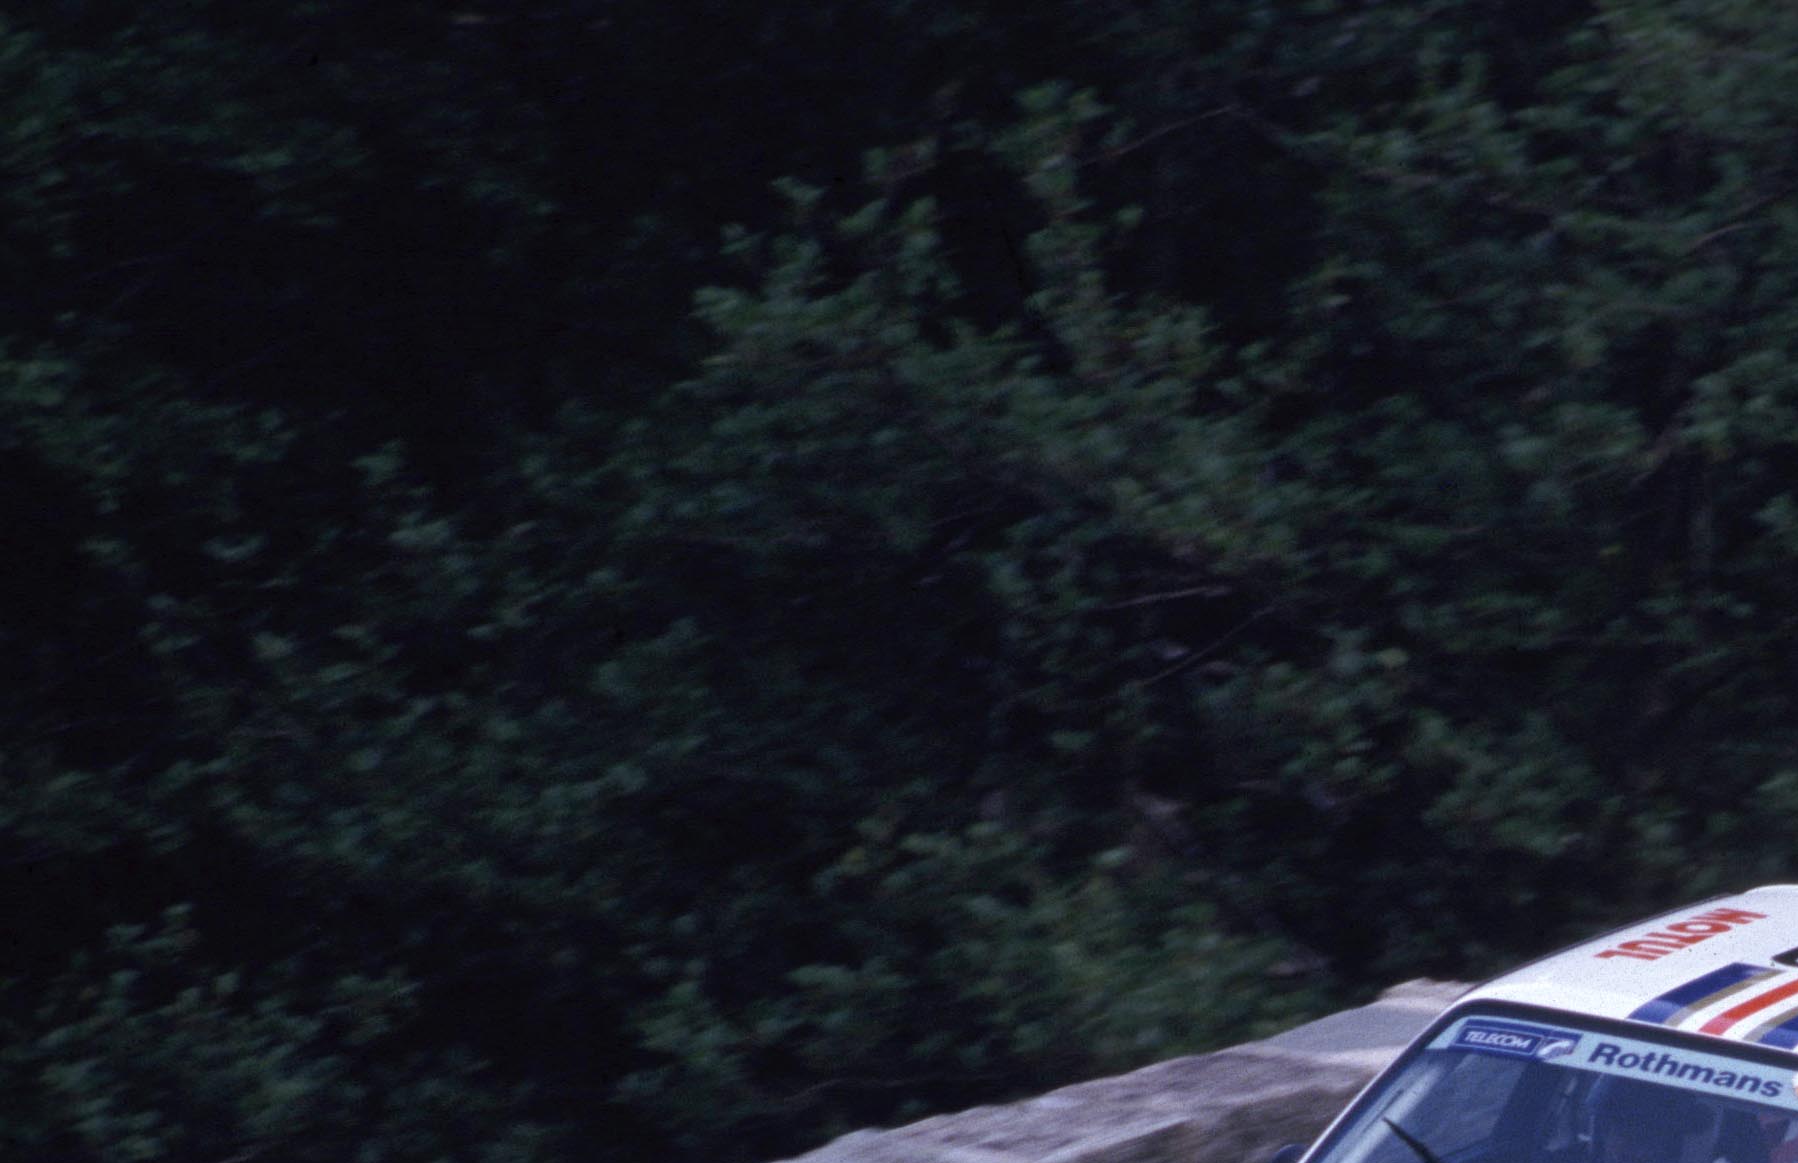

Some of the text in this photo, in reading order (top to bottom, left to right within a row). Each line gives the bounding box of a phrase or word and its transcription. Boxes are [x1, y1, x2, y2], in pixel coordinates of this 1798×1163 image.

[1594, 908, 1768, 960] MOTUL
[1464, 1030, 1533, 1051] TELECOM
[1587, 1042, 1784, 1098] Rothmans
